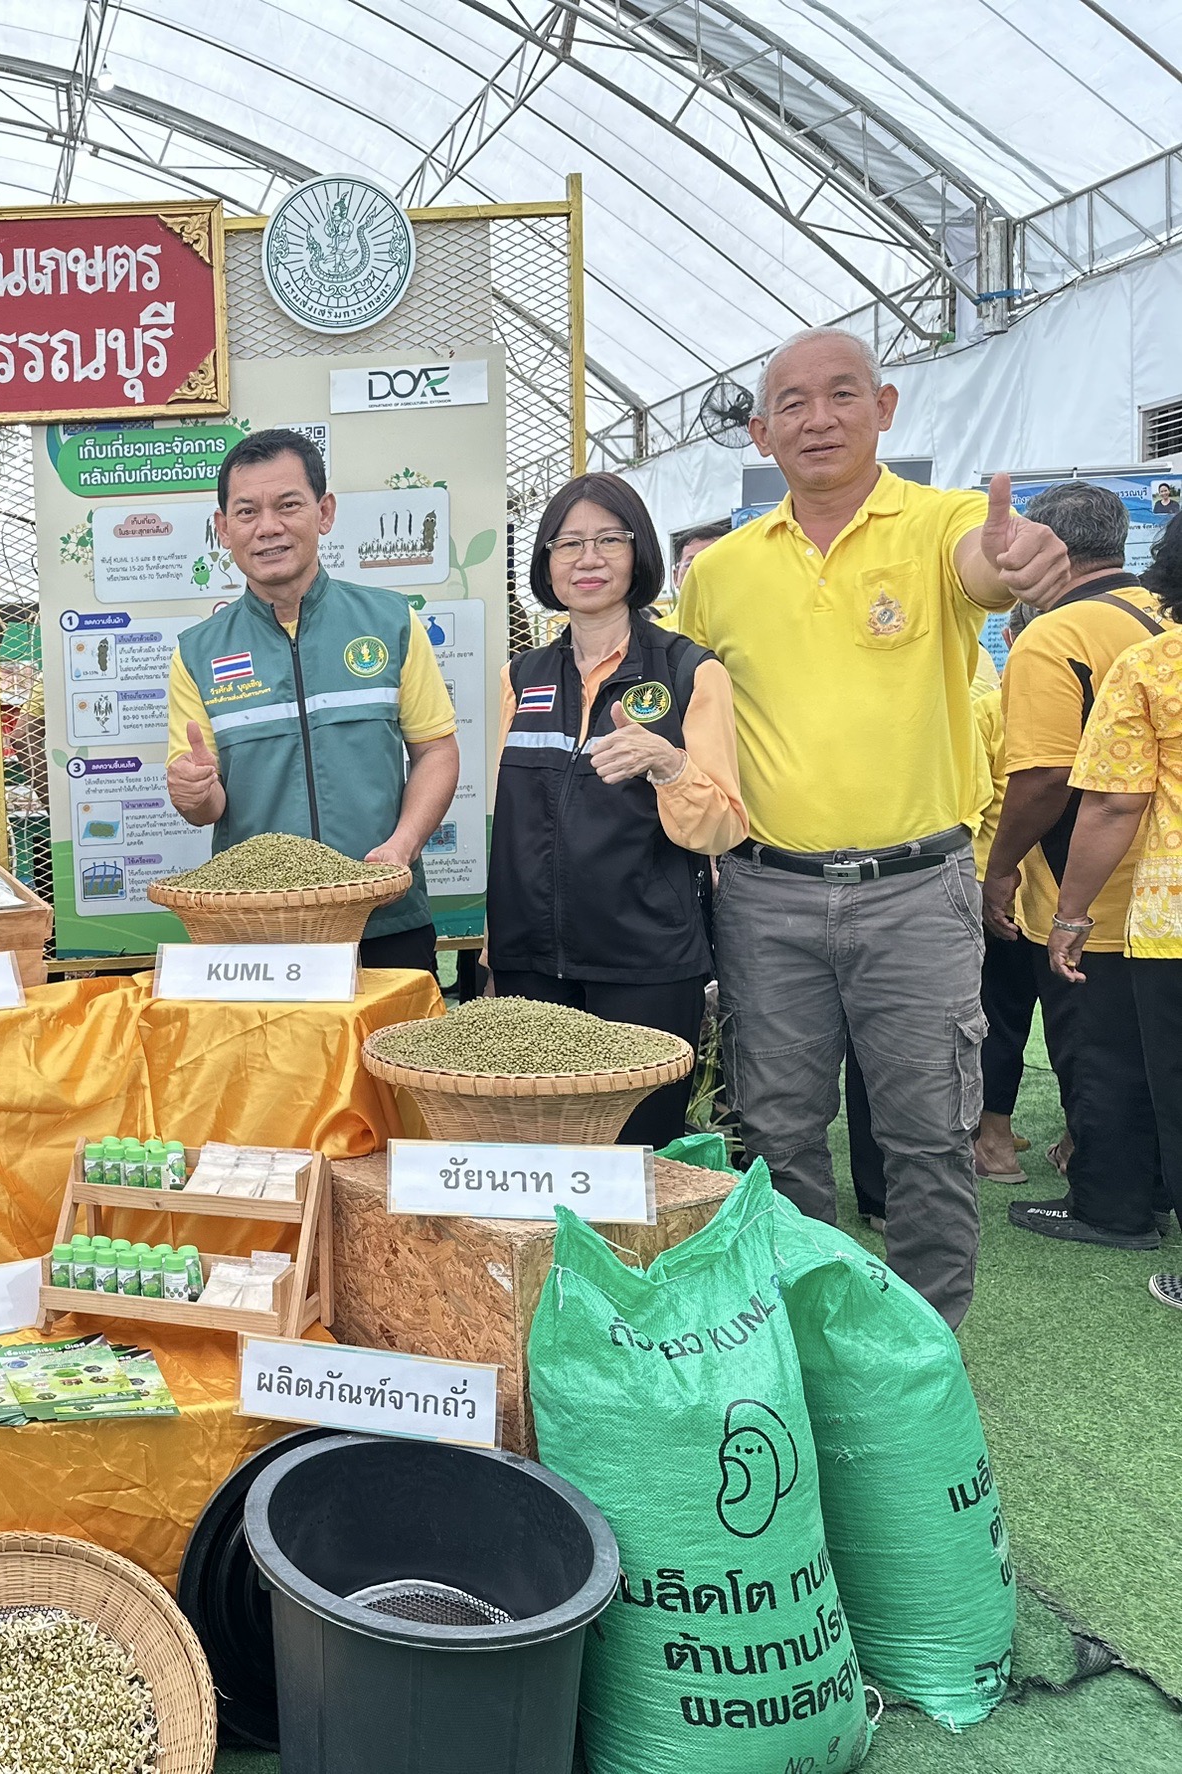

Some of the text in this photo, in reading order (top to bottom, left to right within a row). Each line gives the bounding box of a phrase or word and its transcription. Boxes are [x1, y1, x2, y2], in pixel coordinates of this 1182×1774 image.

[368, 366, 450, 401] DOAE
[78, 432, 226, 460] เก็บเกี่ยวและจัดการ
[67, 616, 74, 626] 1
[73, 763, 81, 772] 3
[206, 962, 302, 982] KUML 8
[438, 1156, 592, 1195] ชัยนาท 3
[705, 1289, 777, 1354] KUML
[255, 1364, 477, 1420] ผลิตภัณฑ์จากถั่ว
